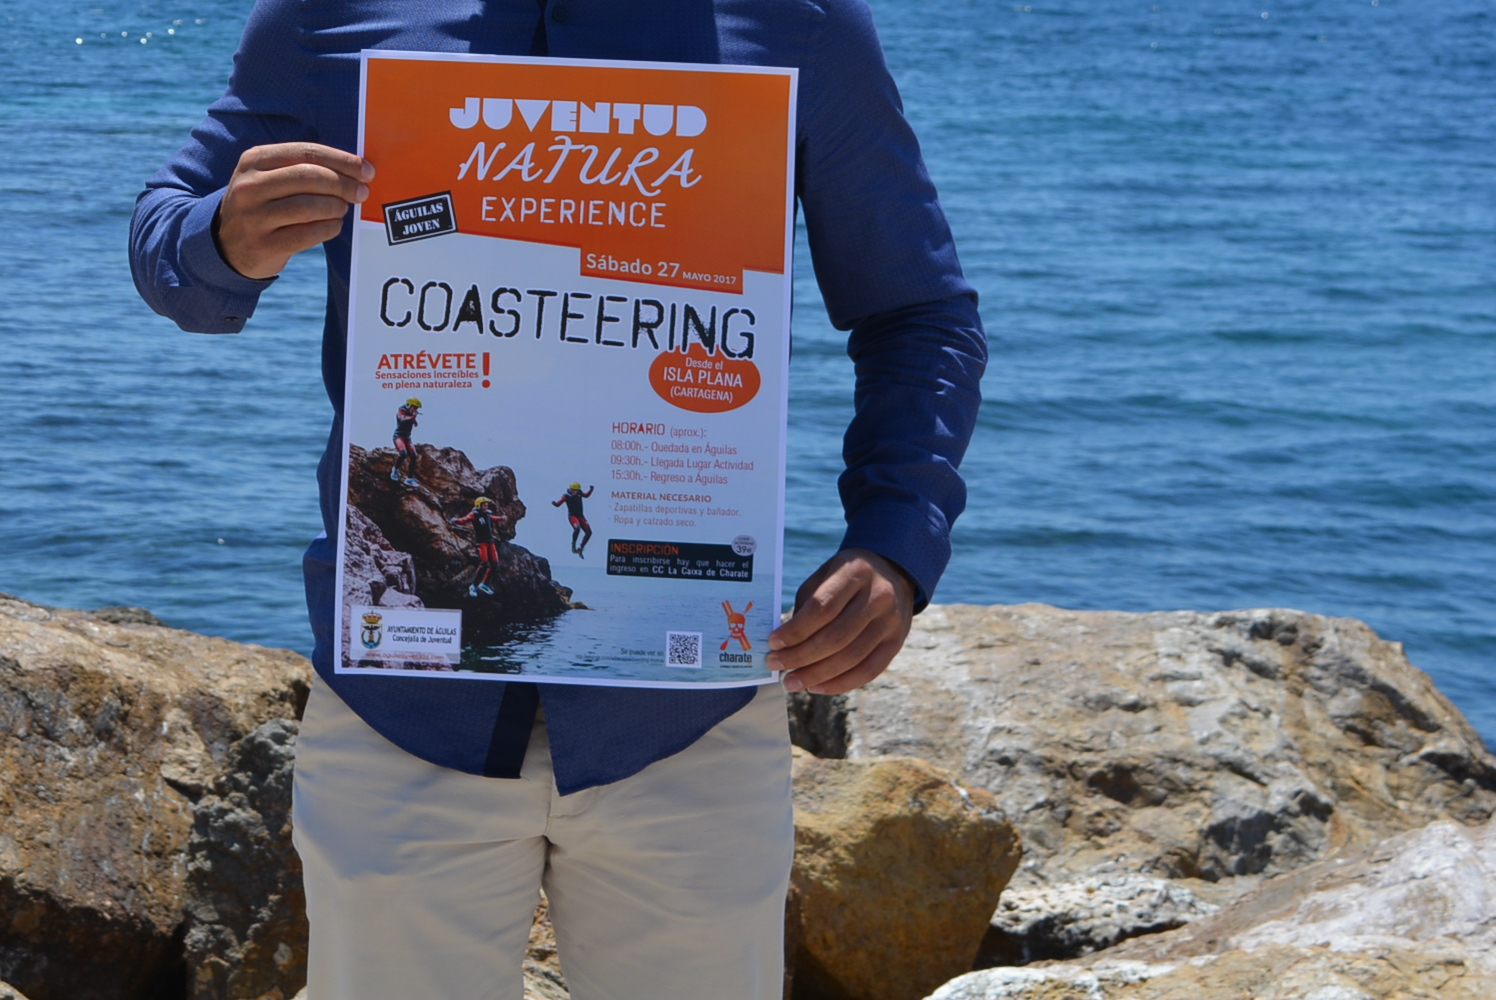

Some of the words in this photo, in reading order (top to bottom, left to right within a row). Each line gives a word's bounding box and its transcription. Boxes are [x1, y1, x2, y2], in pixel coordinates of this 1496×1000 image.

[449, 97, 707, 137] JUVENTUD
[457, 135, 702, 197] NATURA
[394, 202, 444, 222] ÁGUILAS
[481, 196, 666, 228] EXPERIENCE
[402, 218, 441, 235] JOVEN
[586, 253, 652, 275] Sábado
[657, 261, 680, 278] 27
[682, 271, 711, 282] MAYO
[713, 274, 737, 285] 2017
[379, 277, 756, 359] COASTEERING
[377, 350, 476, 370] ATRÉVETE
[685, 357, 712, 369] Desde
[715, 361, 723, 370] el
[375, 370, 432, 379] Sensaciones
[433, 370, 479, 379] increíbles
[663, 366, 694, 384] ISLA
[698, 369, 743, 388] PLANA
[395, 380, 421, 390] plena
[423, 380, 472, 388] naturaleza
[670, 385, 733, 404] (CARTAGENA)
[612, 421, 665, 435] HORARIO
[651, 441, 689, 453] Quedada
[691, 445, 702, 454] en
[704, 441, 737, 456] Águilas
[650, 456, 684, 469] Llegada
[686, 458, 711, 471] Lugar
[713, 459, 754, 470] Actividad
[650, 471, 685, 484] Regreso
[687, 475, 693, 483] a
[695, 471, 728, 486] Águilas
[611, 491, 657, 501] MATERIAL
[659, 493, 712, 503] NECESARIO
[614, 502, 653, 513] Zapatillas
[655, 504, 697, 516] deportivas
[699, 508, 705, 517] y
[613, 515, 634, 526] Ropa
[636, 518, 641, 527] y
[643, 516, 673, 526] calzado
[610, 543, 679, 556] INSCRIPCIÓN
[609, 554, 626, 563] Para
[632, 555, 670, 565] inscribirse
[676, 557, 690, 567] hay
[696, 559, 710, 568] que
[716, 558, 736, 568] hacer
[742, 560, 749, 569] el
[609, 565, 636, 574] ingreso
[652, 565, 664, 574] CC
[668, 566, 677, 575] La
[681, 567, 703, 576] Caixa
[706, 568, 716, 577] de
[719, 568, 749, 578] Charate
[426, 627, 434, 635] DE
[719, 651, 753, 663] charate
